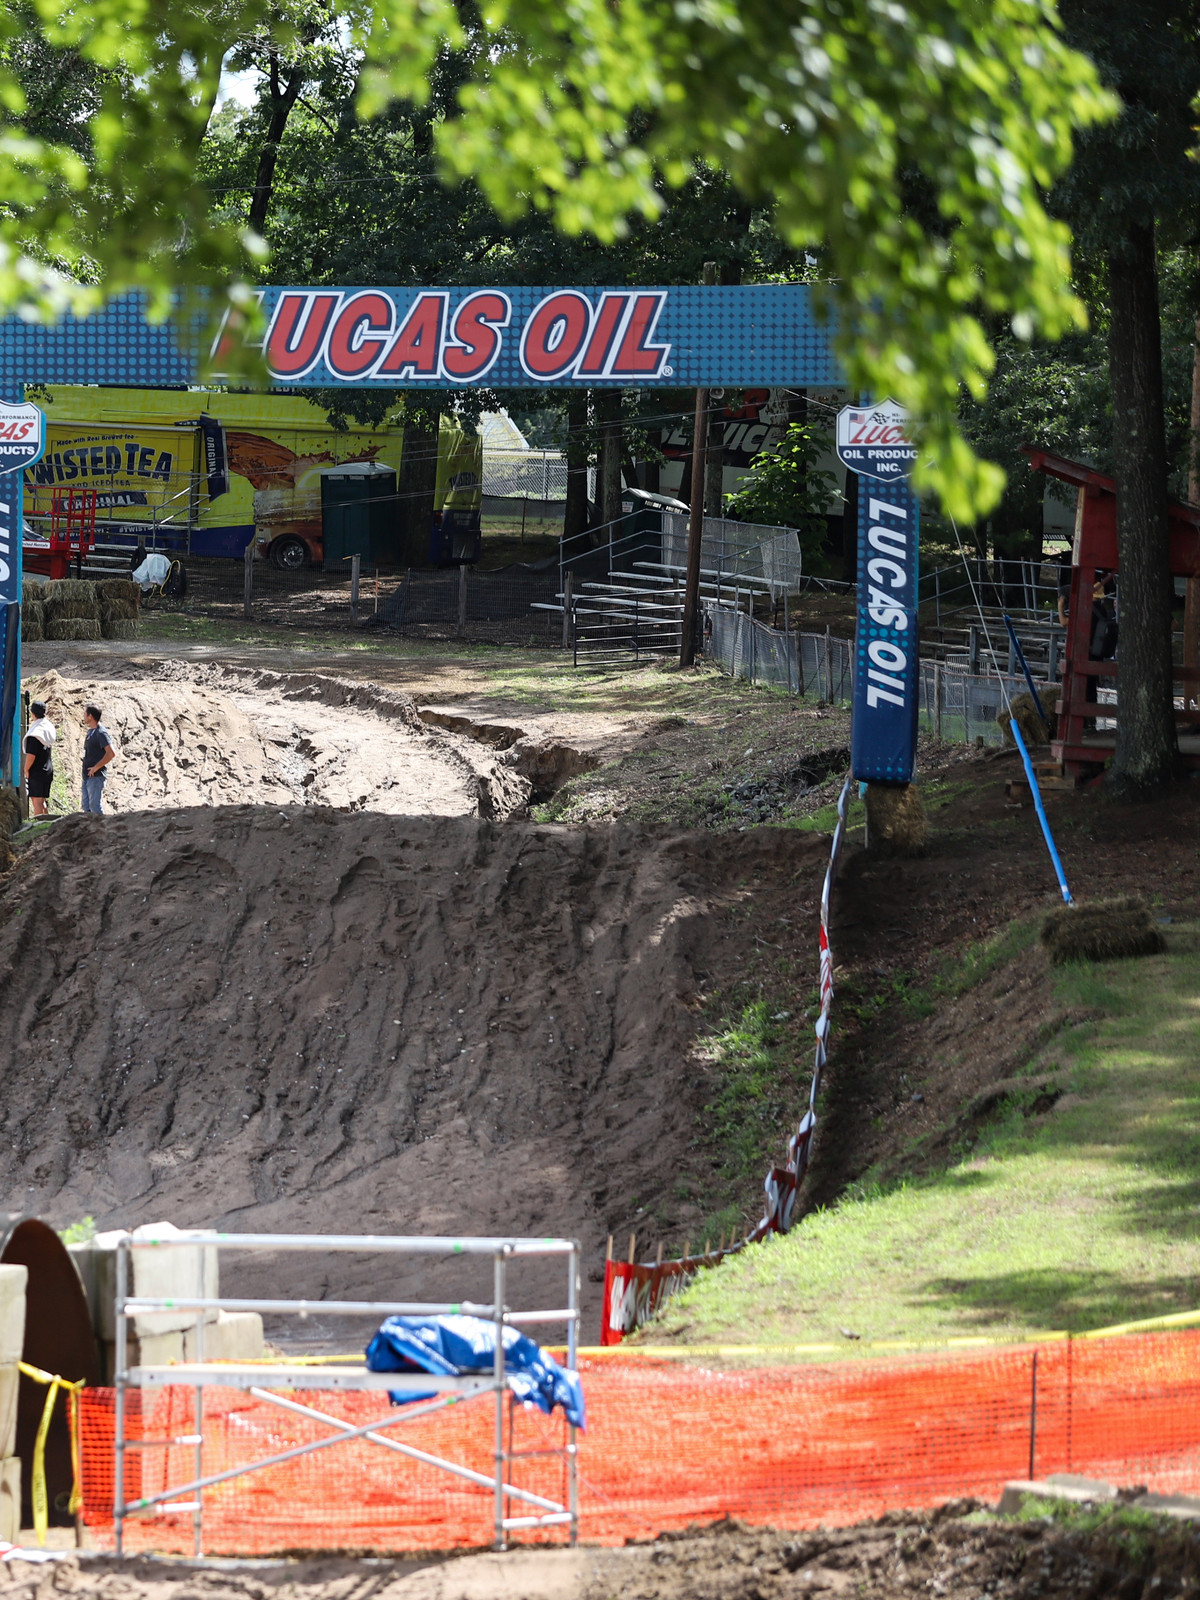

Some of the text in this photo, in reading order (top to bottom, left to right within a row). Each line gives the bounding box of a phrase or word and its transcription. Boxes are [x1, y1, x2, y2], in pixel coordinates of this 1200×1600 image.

[519, 289, 671, 380] OIL
[849, 425, 919, 445] LUCA
[124, 443, 173, 483] TEA
[207, 436, 217, 475] ORIGINA
[843, 450, 932, 460] OIL PRODUC
[876, 463, 902, 472] INC.
[866, 497, 908, 709] LUCAS OIL
